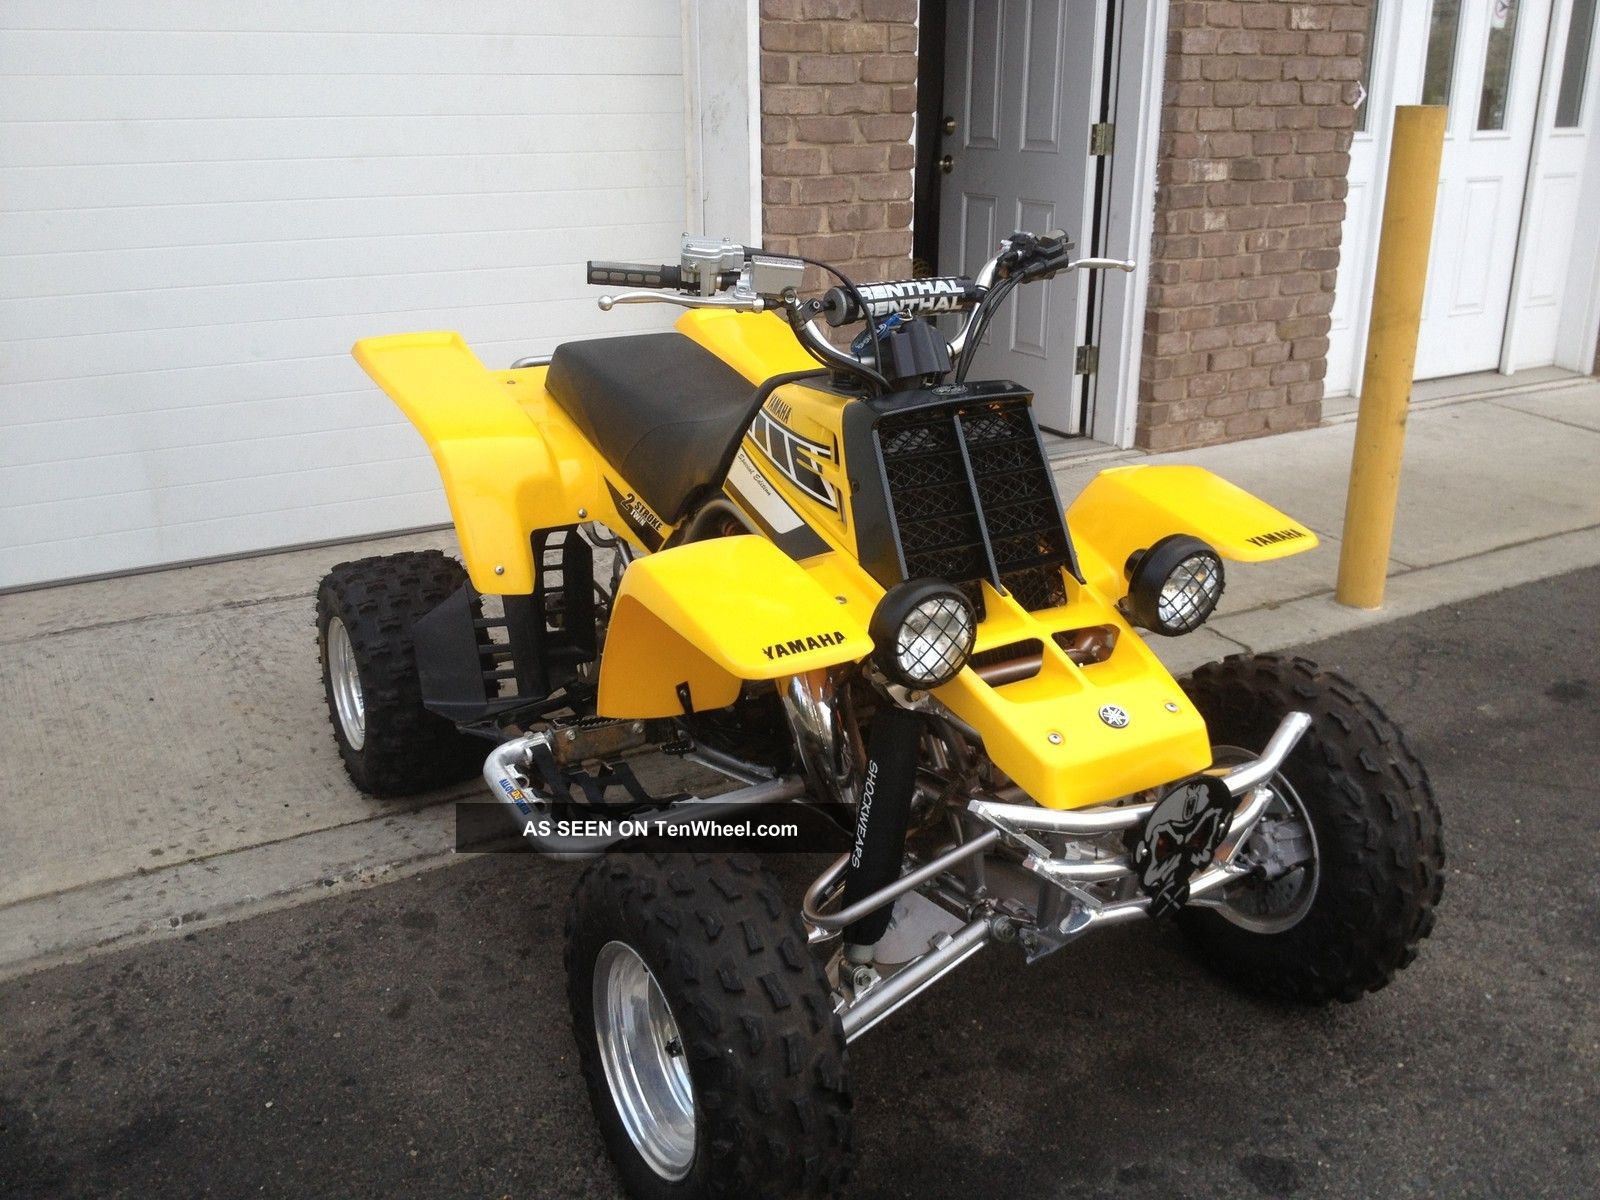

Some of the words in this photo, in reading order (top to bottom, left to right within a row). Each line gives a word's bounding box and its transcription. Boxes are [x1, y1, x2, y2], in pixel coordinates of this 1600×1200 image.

[856, 279, 965, 301] RENTHAL
[767, 393, 792, 425] YAMAHA
[753, 475, 772, 497] Edition
[621, 493, 636, 511] 2
[634, 501, 663, 532] STROKE
[630, 508, 647, 527] TWIN
[1245, 529, 1306, 547] YAMAHA
[762, 630, 847, 660] YAMAHA
[851, 759, 879, 869] SHOCKWEARS
